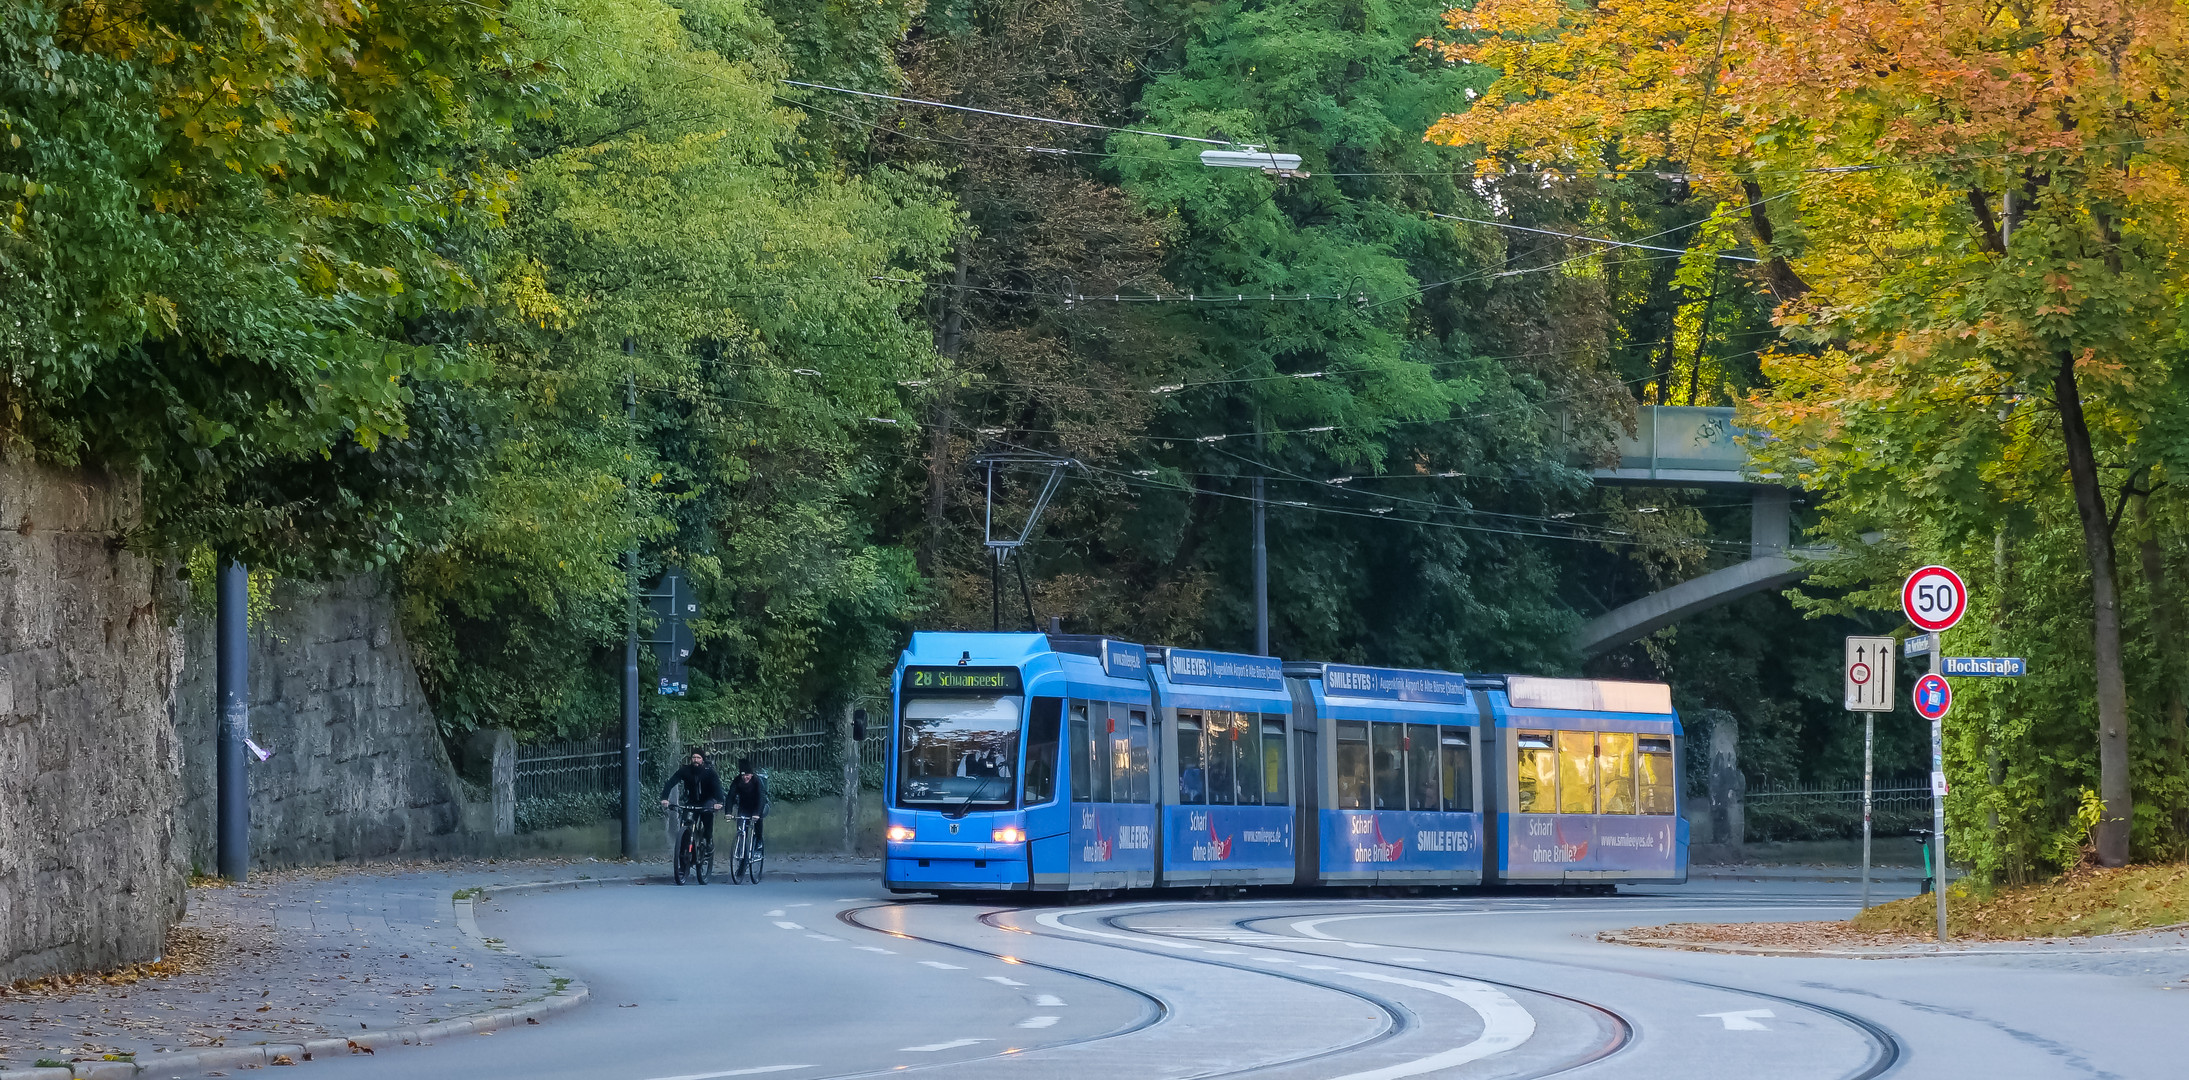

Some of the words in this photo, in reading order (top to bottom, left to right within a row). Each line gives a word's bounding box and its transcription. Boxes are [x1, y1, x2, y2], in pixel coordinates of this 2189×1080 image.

[1918, 585, 1952, 612] 50
[1172, 656, 1191, 675] SMILE
[1191, 658, 1207, 676] EYES
[1947, 659, 2019, 675] Hochstraße
[915, 671, 932, 686] 28
[939, 672, 1009, 687] Schwanseestr.
[1329, 671, 1351, 689] SMILE
[1352, 673, 1371, 690] EYES
[1380, 677, 1404, 693] Augenklinik
[1405, 679, 1419, 694] Airport
[1424, 680, 1433, 692] Alte
[1434, 681, 1445, 694] Börse
[1446, 681, 1465, 697] (Stachus)
[1082, 807, 1095, 830] Scharf
[1190, 811, 1207, 831] Scharf
[1351, 815, 1374, 835] Scharf
[1529, 818, 1554, 836] Scharf
[1119, 825, 1135, 849] SMILE
[1135, 826, 1149, 849] EYES
[1243, 827, 1281, 847] www.smileeyes.de
[1418, 830, 1444, 851] SMILE
[1446, 831, 1468, 852] EYES
[1601, 833, 1654, 850] www.smileeyes.de
[1083, 840, 1094, 862] ohne
[1192, 841, 1206, 862] ohne
[1207, 841, 1225, 861] Brille?
[1355, 843, 1372, 863] ohne
[1373, 843, 1394, 862] Brille?
[1533, 845, 1552, 862] ohne
[1553, 845, 1577, 862] Brille?
